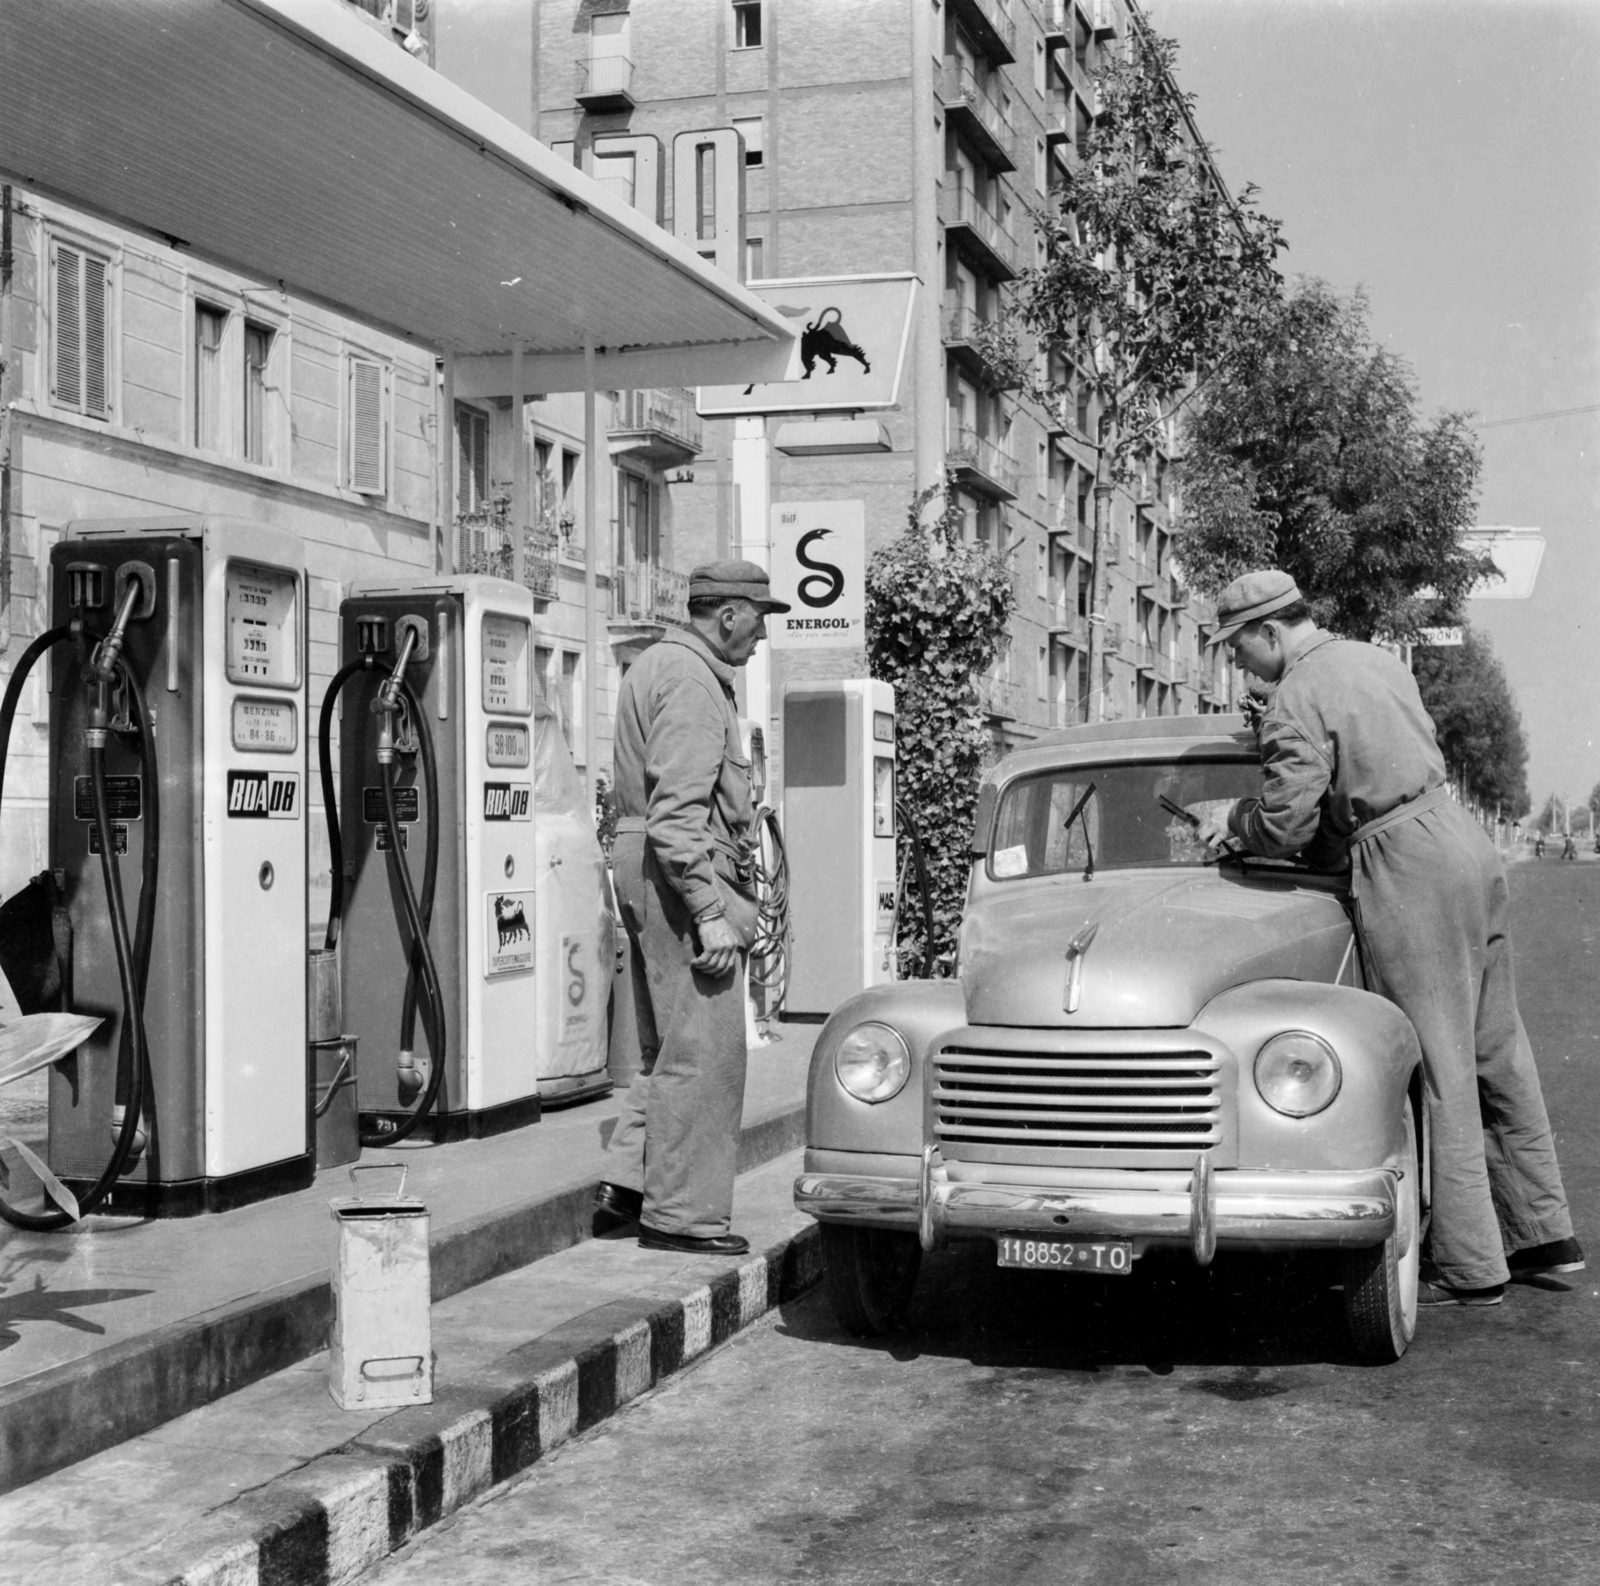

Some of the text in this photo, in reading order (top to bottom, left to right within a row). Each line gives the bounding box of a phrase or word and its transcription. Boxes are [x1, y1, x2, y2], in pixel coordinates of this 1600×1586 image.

[786, 618, 849, 630] ENERGOL
[244, 706, 280, 717] BENZINA
[229, 779, 268, 812] BOA
[485, 789, 510, 816] BOA
[1003, 1239, 1125, 1269] 118852 TO
